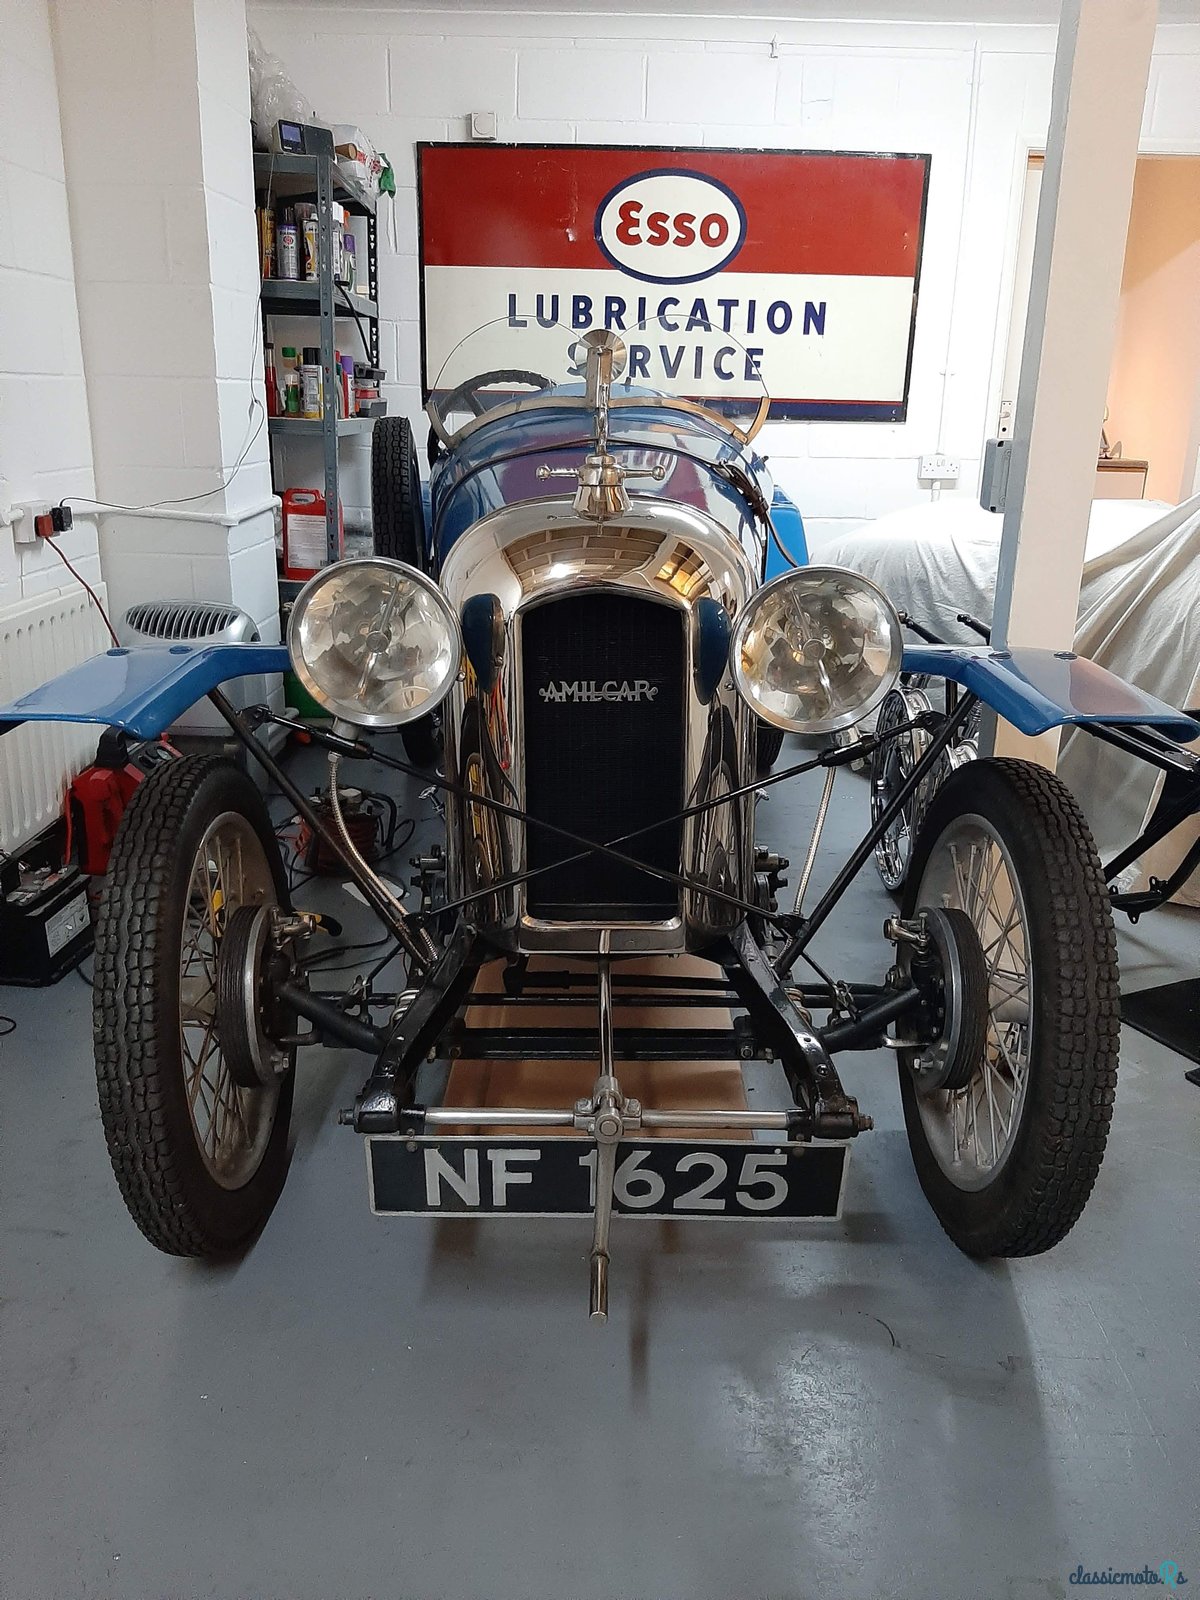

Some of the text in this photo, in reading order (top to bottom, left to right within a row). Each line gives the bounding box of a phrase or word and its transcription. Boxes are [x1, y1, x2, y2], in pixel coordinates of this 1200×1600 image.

[507, 293, 827, 336] LUBRICATION
[566, 344, 765, 381] SRVICE
[539, 680, 658, 702] AMILCAR
[424, 1148, 788, 1211] NF 1625
